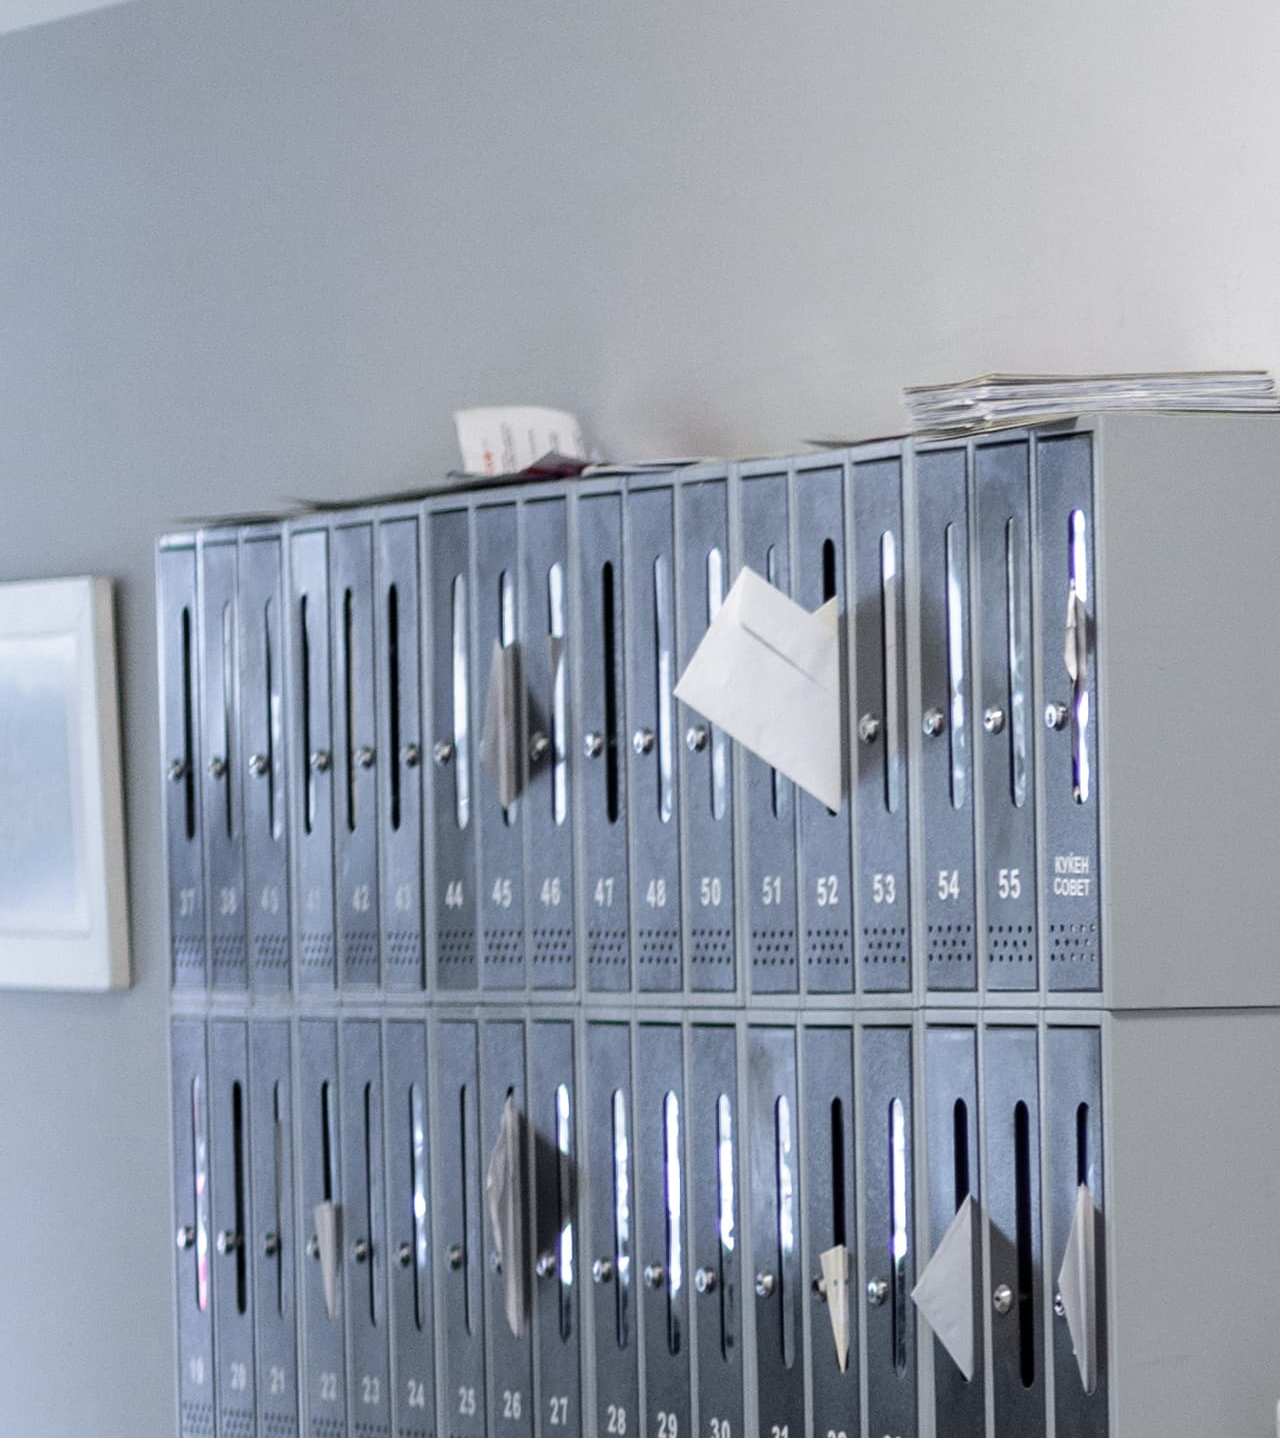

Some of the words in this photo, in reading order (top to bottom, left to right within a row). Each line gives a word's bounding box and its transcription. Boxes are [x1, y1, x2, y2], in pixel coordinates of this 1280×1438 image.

[352, 884, 370, 912] 42
[445, 881, 464, 908] 44
[491, 877, 512, 908] 45
[540, 877, 561, 906] 46
[594, 877, 614, 907] 47
[645, 878, 667, 907] 48
[700, 877, 722, 907] 50
[762, 875, 782, 905] 51
[816, 874, 839, 907] 52
[872, 873, 896, 904] 53
[938, 869, 960, 900] 54
[998, 868, 1021, 899] 55
[1053, 877, 1091, 897] СОВЕТ
[319, 1372, 337, 1401] 22
[362, 1375, 380, 1405] 23
[407, 1378, 425, 1409] 24
[458, 1385, 476, 1416] 25
[503, 1390, 522, 1420] 26
[549, 1396, 569, 1425] 27
[607, 1404, 627, 1436] 28
